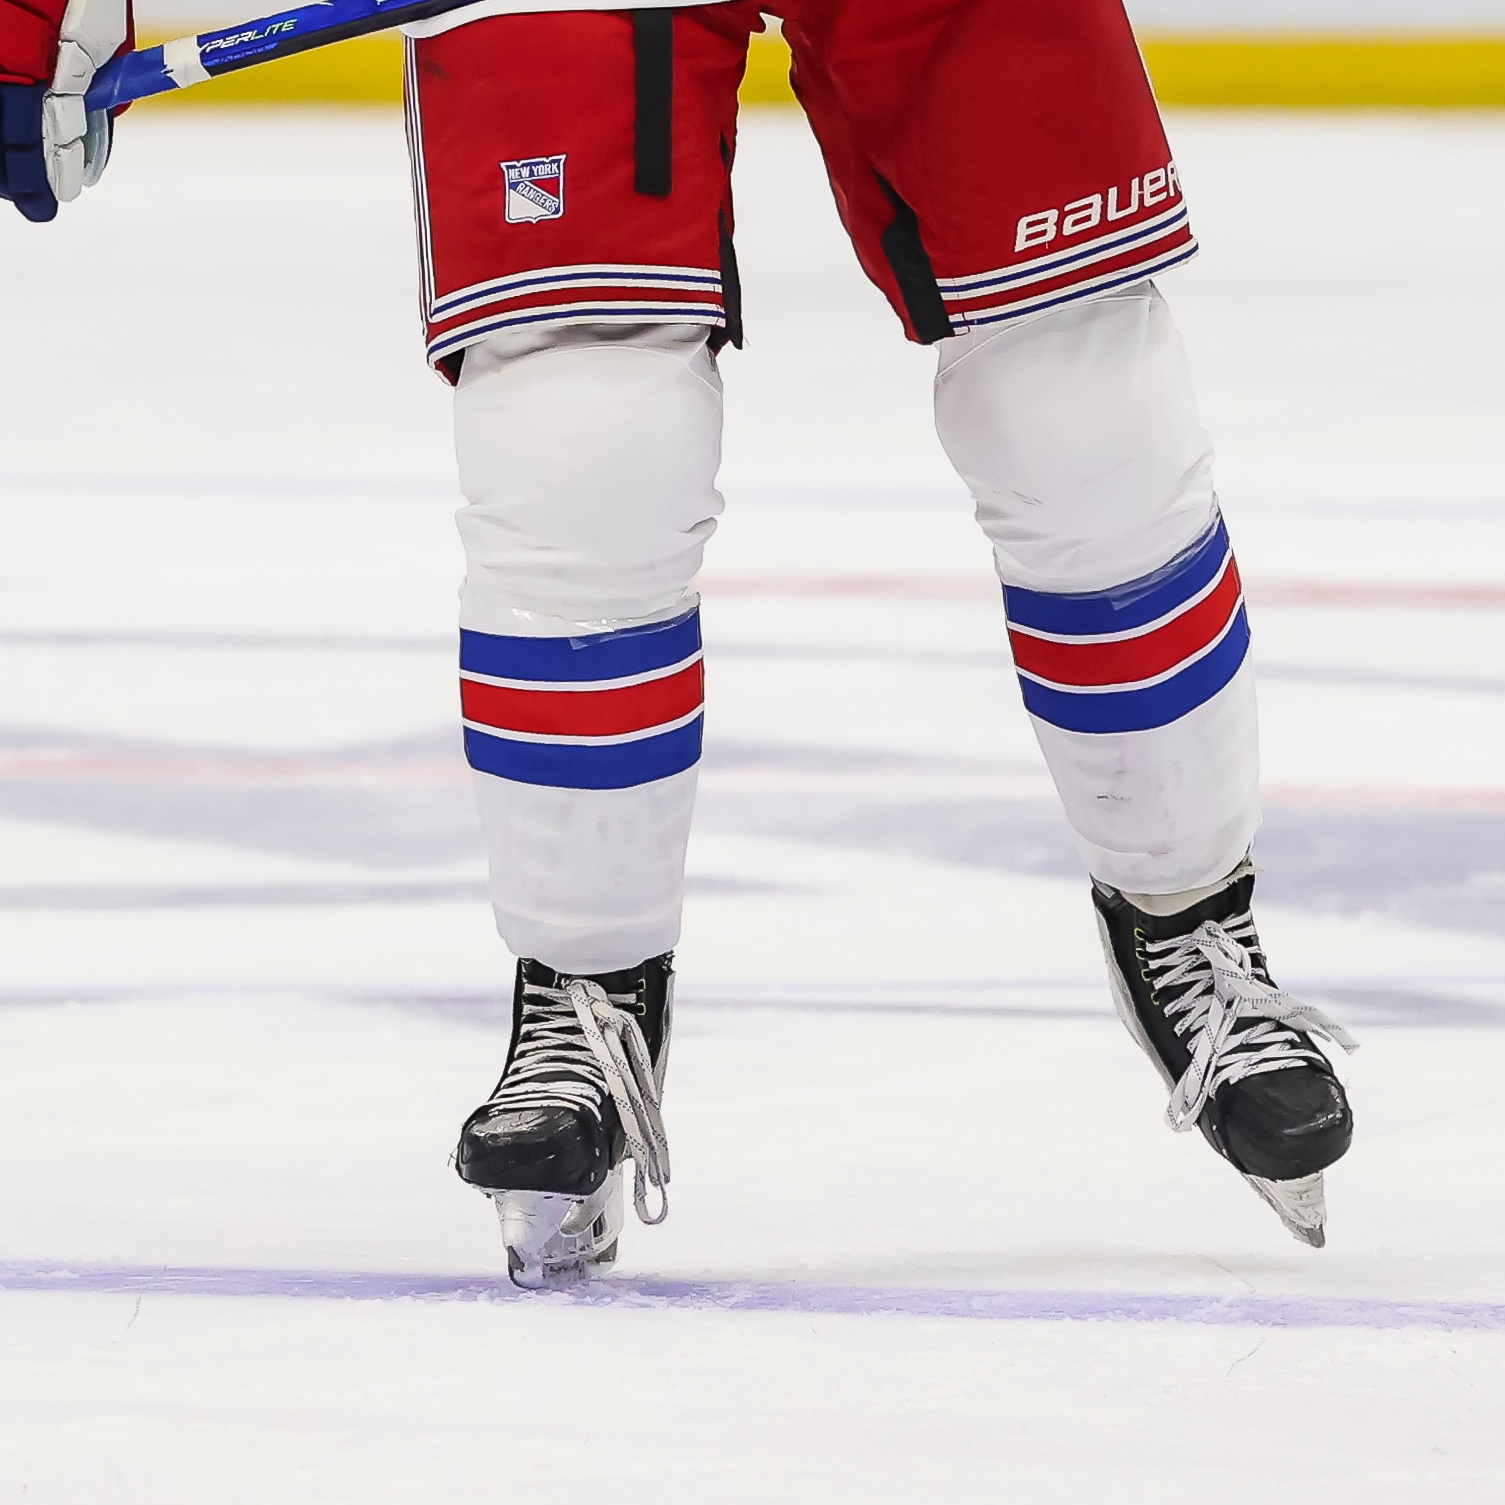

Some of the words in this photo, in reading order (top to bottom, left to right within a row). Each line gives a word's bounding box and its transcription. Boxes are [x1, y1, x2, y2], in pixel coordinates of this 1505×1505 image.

[509, 165, 531, 180] NEW
[531, 162, 560, 176] YORK
[515, 181, 559, 214] RANGERS
